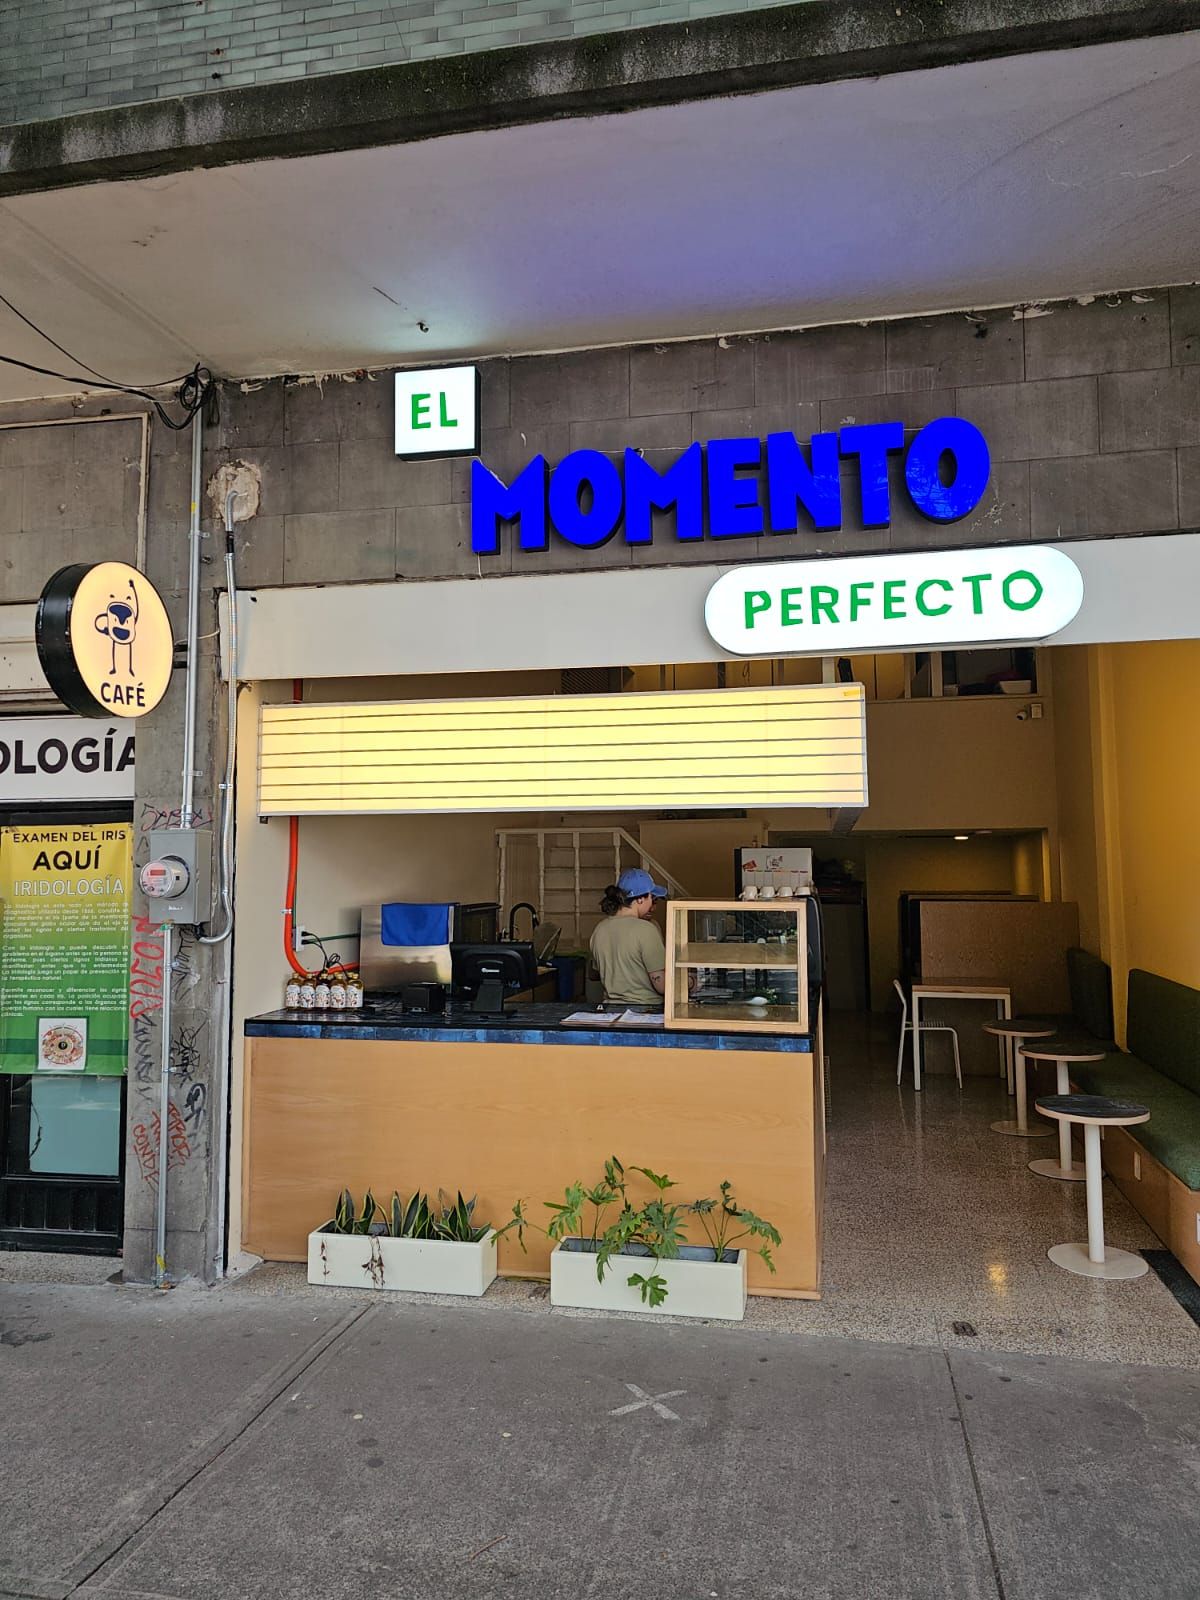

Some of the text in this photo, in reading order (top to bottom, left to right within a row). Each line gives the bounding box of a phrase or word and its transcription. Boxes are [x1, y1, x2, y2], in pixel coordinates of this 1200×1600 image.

[411, 391, 458, 430] EL
[471, 417, 991, 554] MOMENTO
[744, 570, 1044, 629] PERFECTO
[100, 682, 146, 707] CAFÉ
[13, 830, 126, 843] EXAMEN DEL IRIS
[33, 844, 102, 871] AQUÍ
[14, 874, 124, 896] IRIDOLOGÍA
